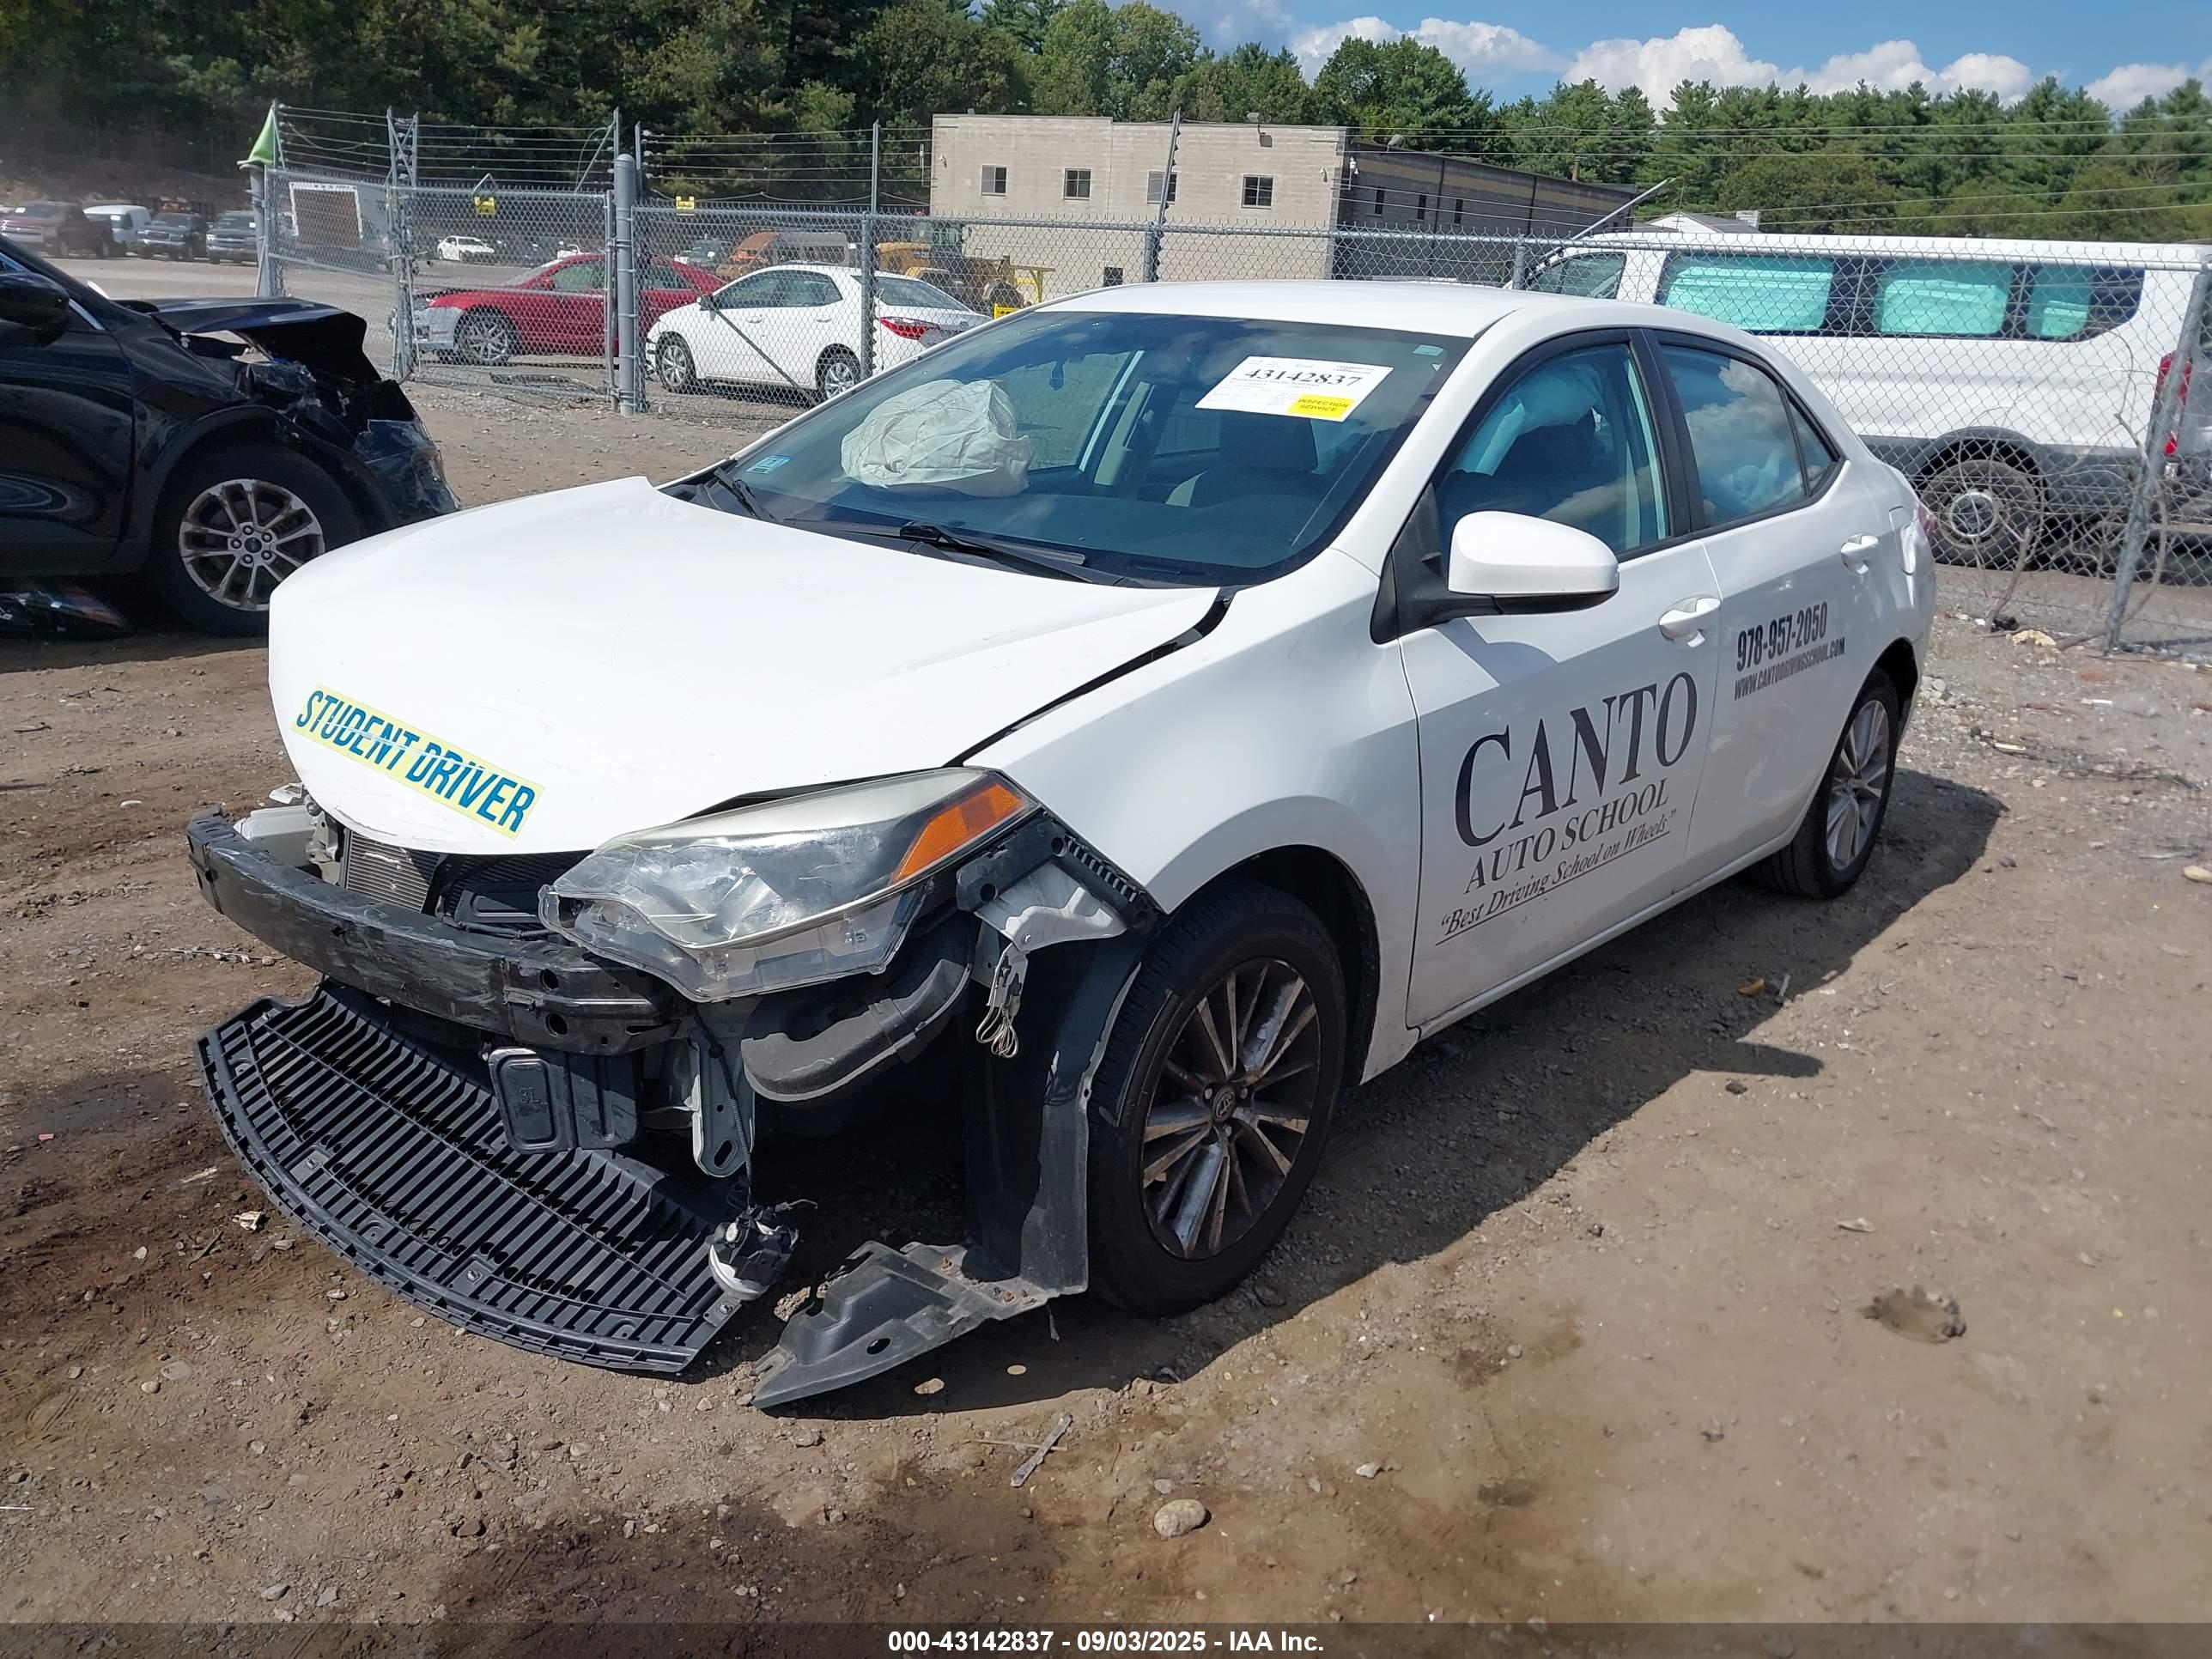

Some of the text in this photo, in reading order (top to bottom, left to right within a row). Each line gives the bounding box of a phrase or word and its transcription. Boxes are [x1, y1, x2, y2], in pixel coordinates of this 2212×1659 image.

[1244, 369, 1362, 387] 43142837
[1298, 398, 1349, 408] INSPECTION
[1736, 601, 1828, 672] 978-957-2050
[296, 690, 536, 833] STUDENT DRIVER
[1455, 672, 1698, 847] CANTO
[1463, 777, 1669, 894] AUTO SCHOOL
[1486, 874, 1549, 915] Driving
[1552, 844, 1602, 884] School
[1603, 841, 1621, 860] on
